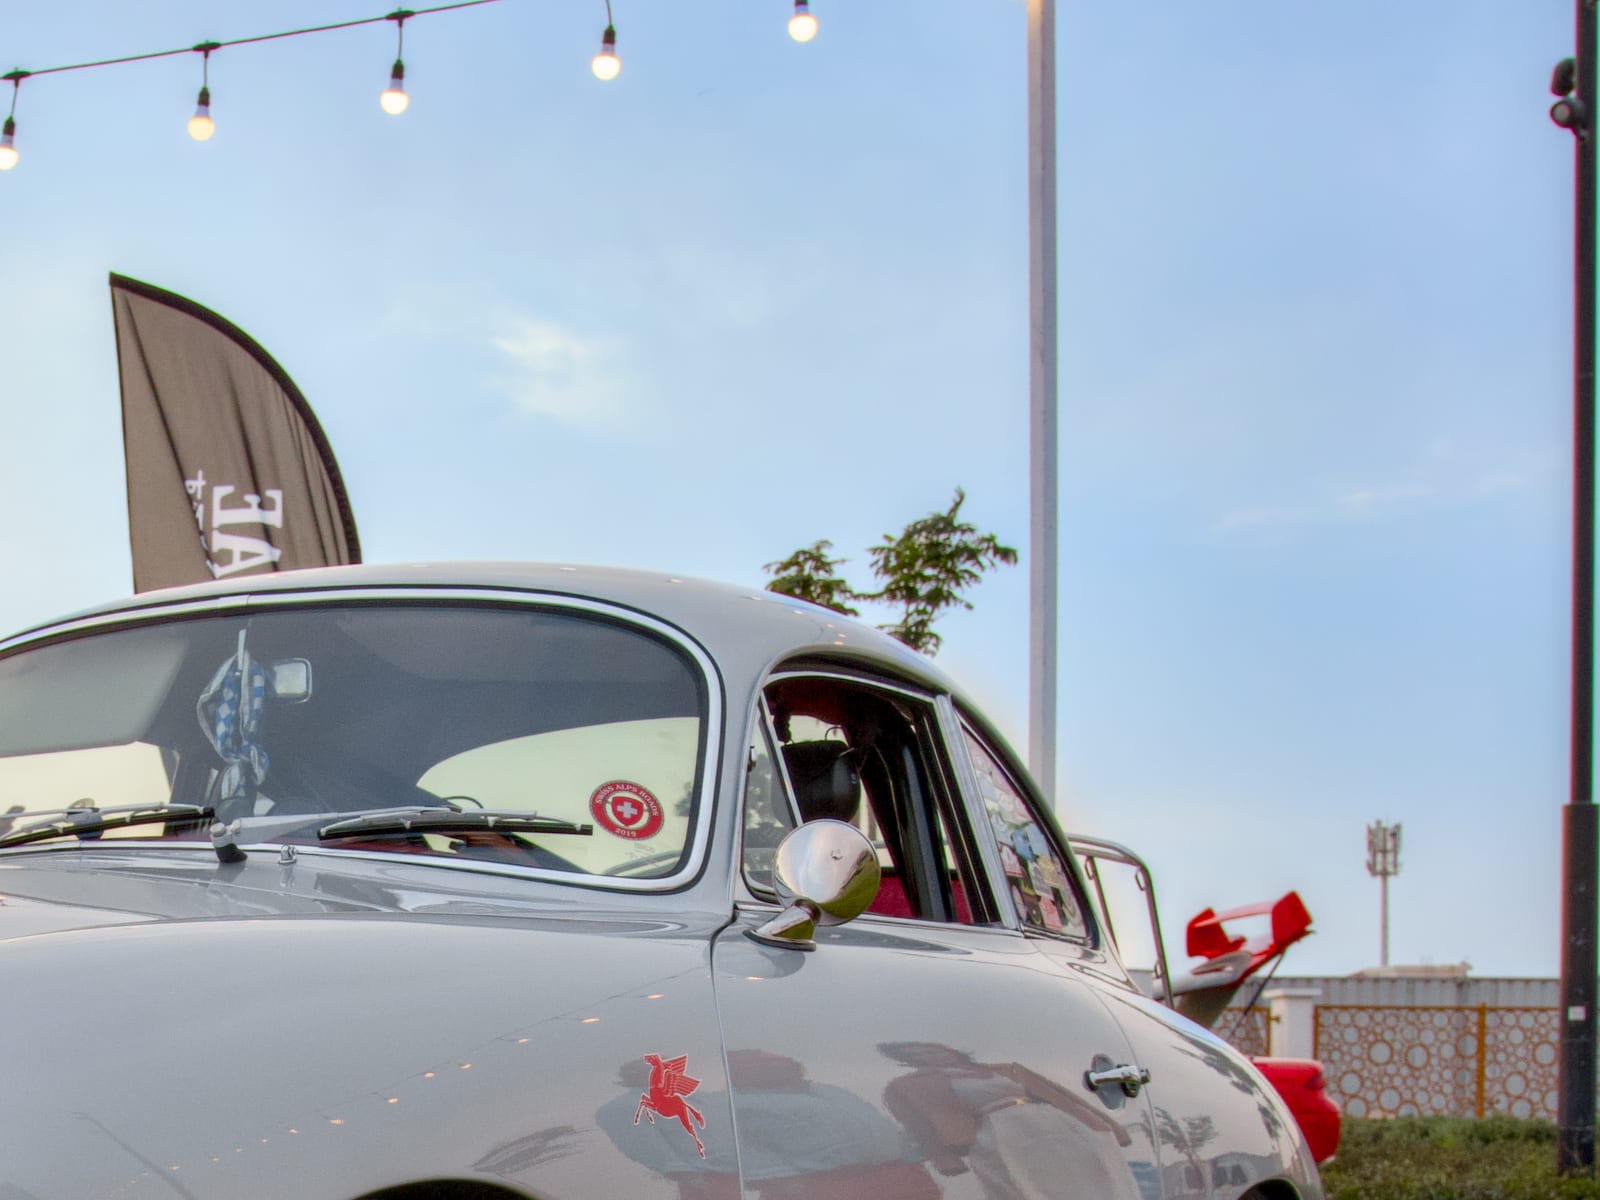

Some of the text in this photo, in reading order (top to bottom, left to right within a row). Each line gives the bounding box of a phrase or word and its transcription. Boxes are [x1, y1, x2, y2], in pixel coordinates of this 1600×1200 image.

[595, 783, 659, 817] SWISS ALPS ROADS
[615, 827, 638, 838] 2019
